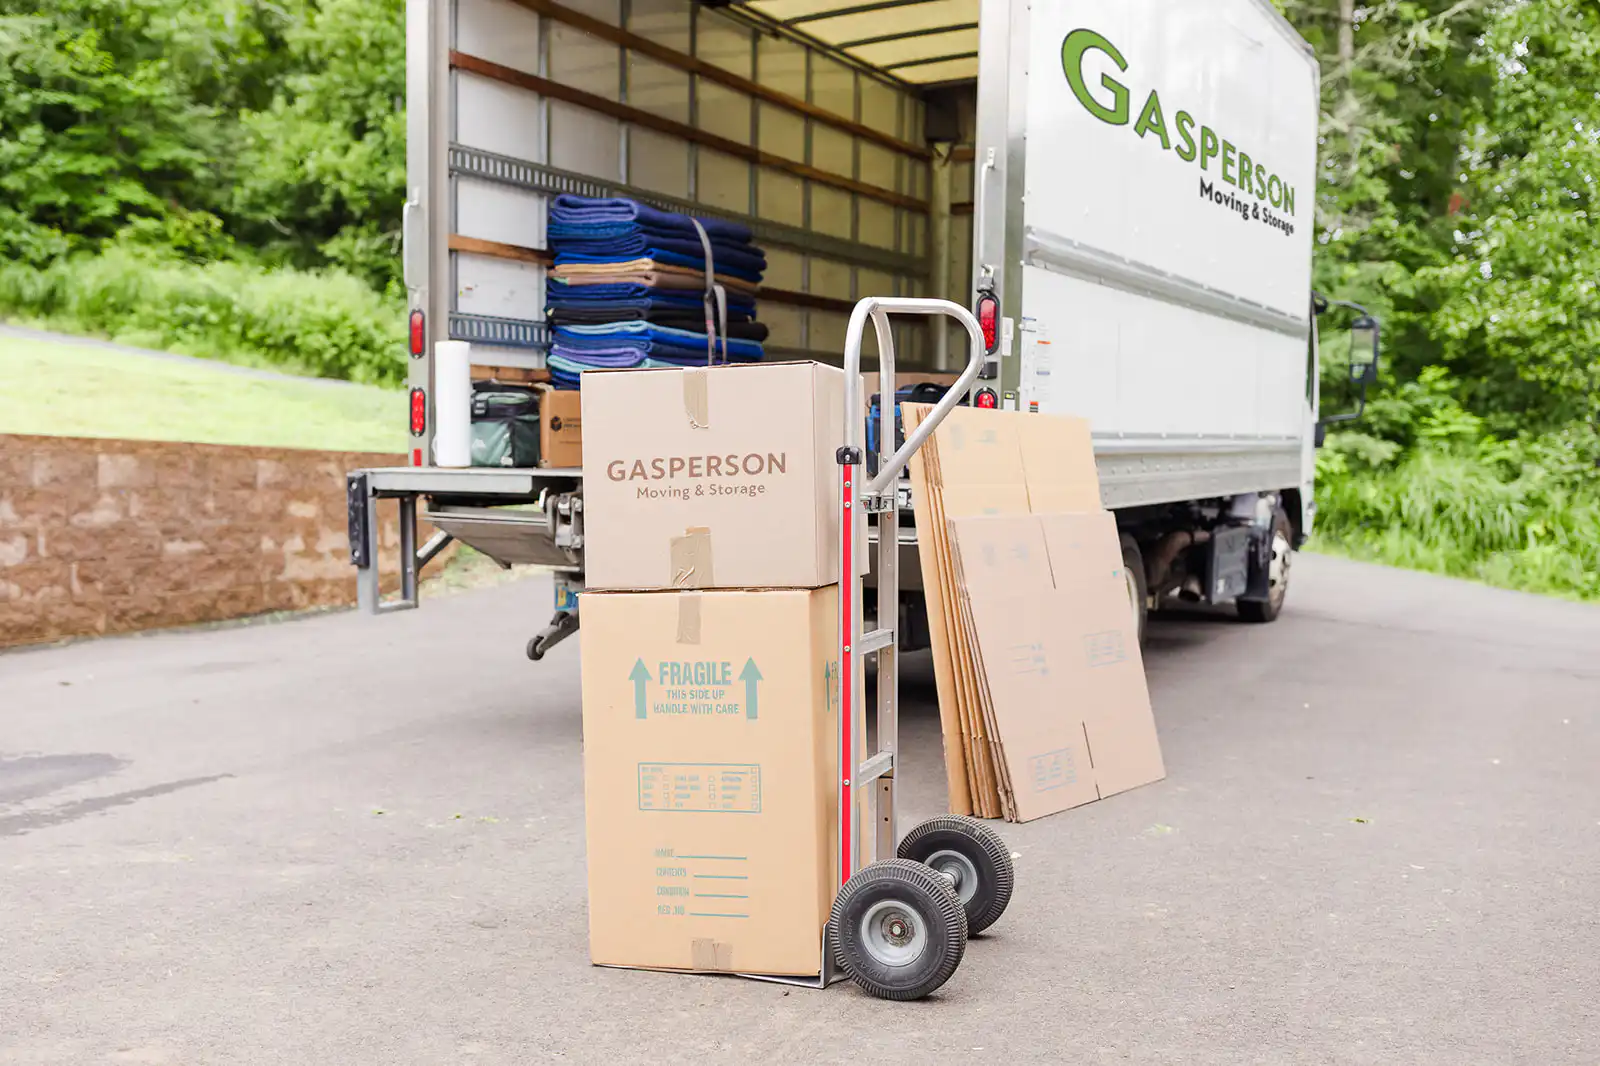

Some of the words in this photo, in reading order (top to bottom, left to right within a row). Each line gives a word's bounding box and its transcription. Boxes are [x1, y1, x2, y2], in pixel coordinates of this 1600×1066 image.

[1061, 28, 1295, 216] GASPERSON
[1200, 176, 1249, 221] Moving
[1252, 202, 1260, 220] &
[1263, 207, 1294, 236] Storage
[607, 452, 786, 482] GASPERSON
[636, 486, 690, 501] Moving
[695, 484, 704, 496] &
[709, 483, 766, 497] Storage
[659, 661, 732, 686] FRAGILE
[666, 689, 687, 701] THIS
[689, 689, 711, 701] SIDE
[712, 689, 725, 701] UP
[653, 702, 689, 715] HANDLE
[690, 703, 713, 715] WITH
[716, 703, 740, 715] CARE
